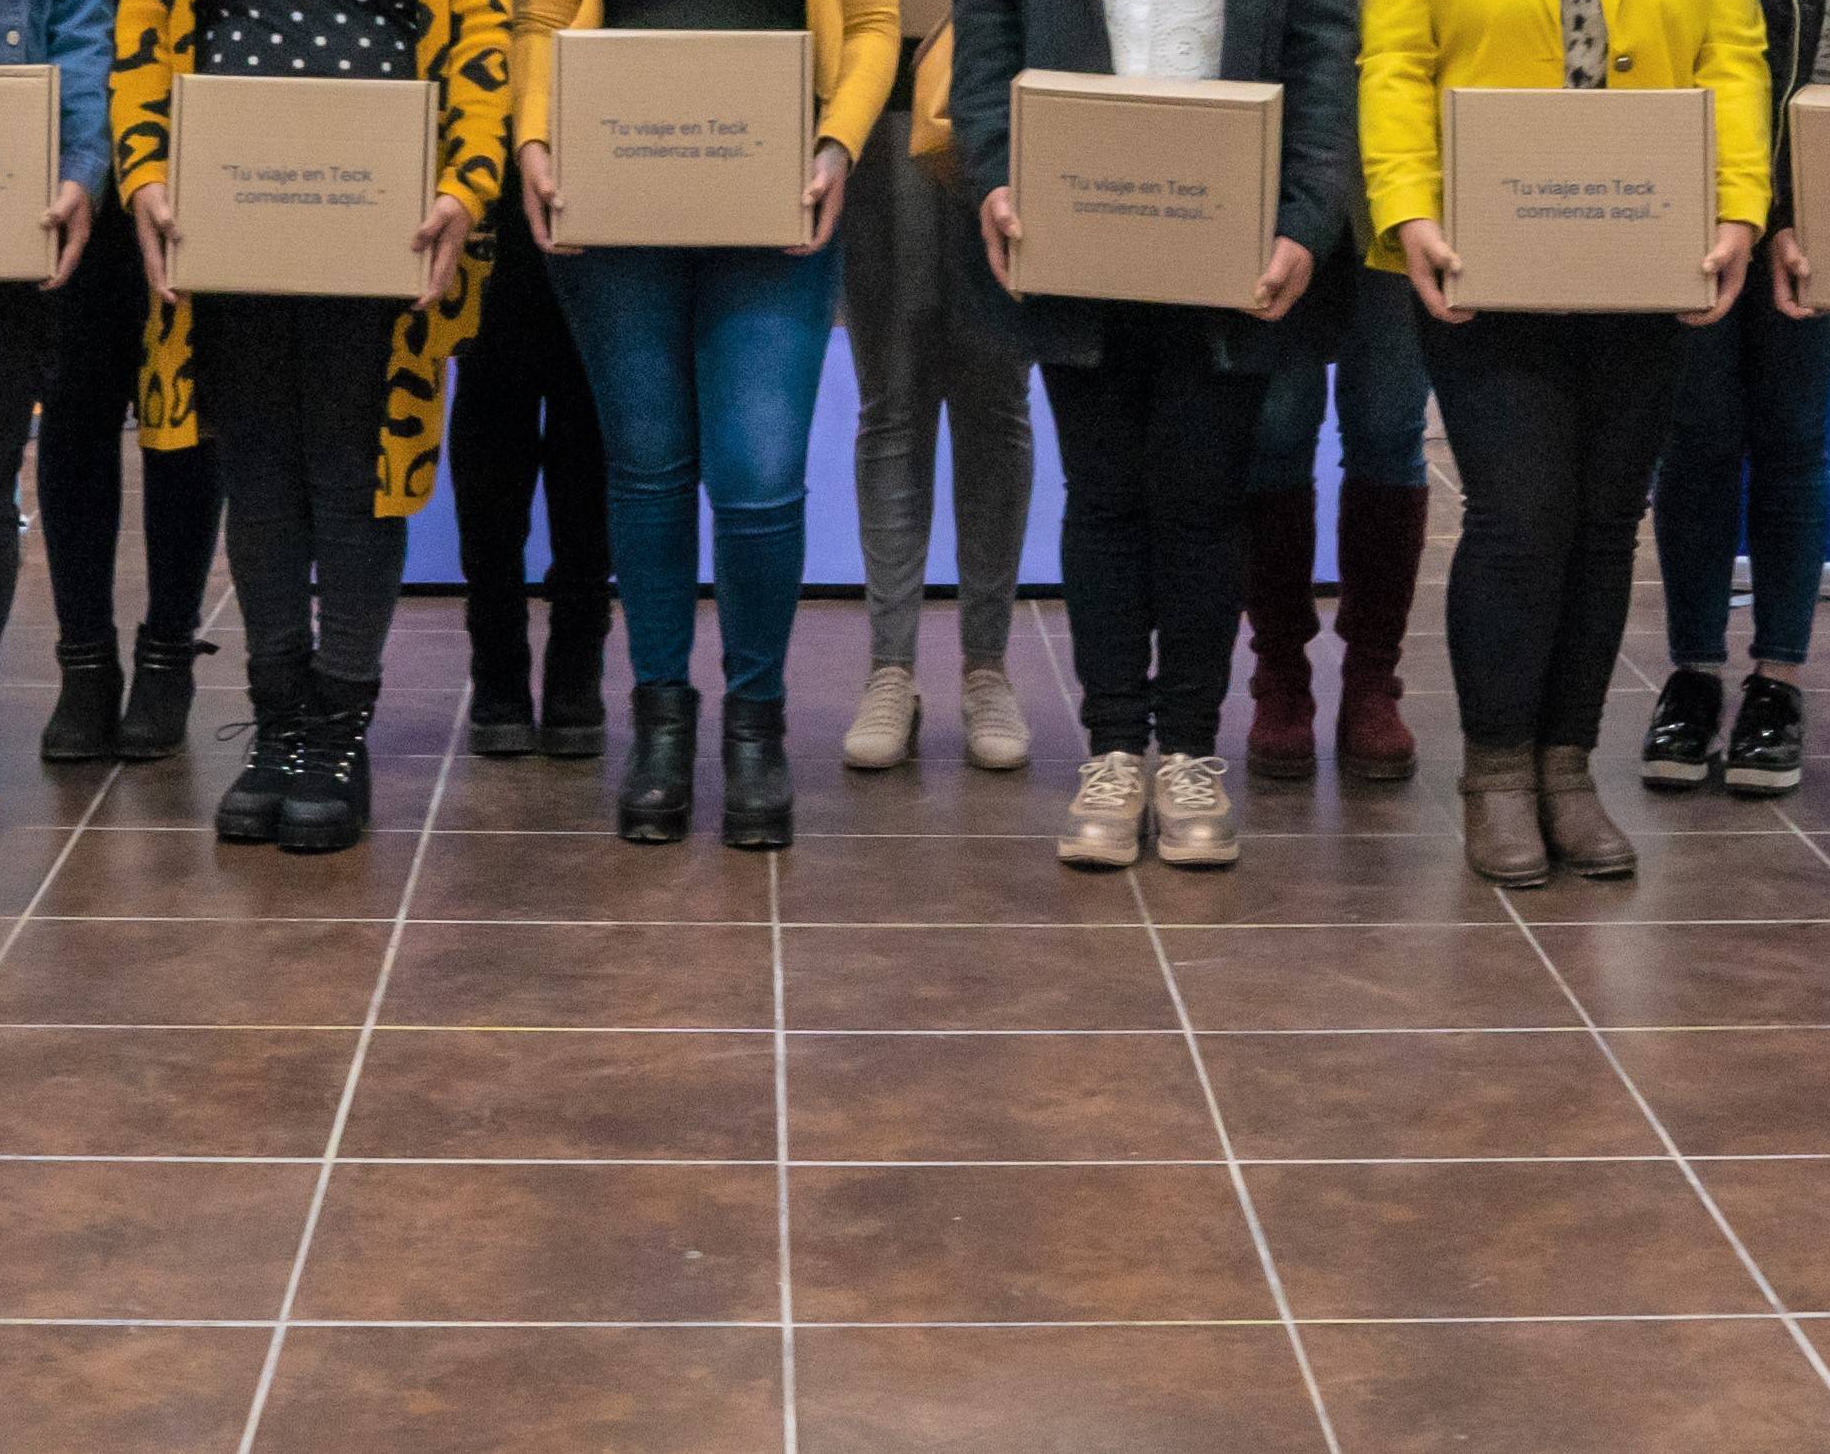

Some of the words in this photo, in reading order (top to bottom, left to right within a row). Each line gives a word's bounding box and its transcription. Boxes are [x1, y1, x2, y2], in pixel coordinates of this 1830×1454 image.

[1537, 179, 1581, 200] viaje
[1584, 183, 1608, 196] en
[1612, 178, 1656, 196] Teck
[1516, 203, 1606, 219] comienza
